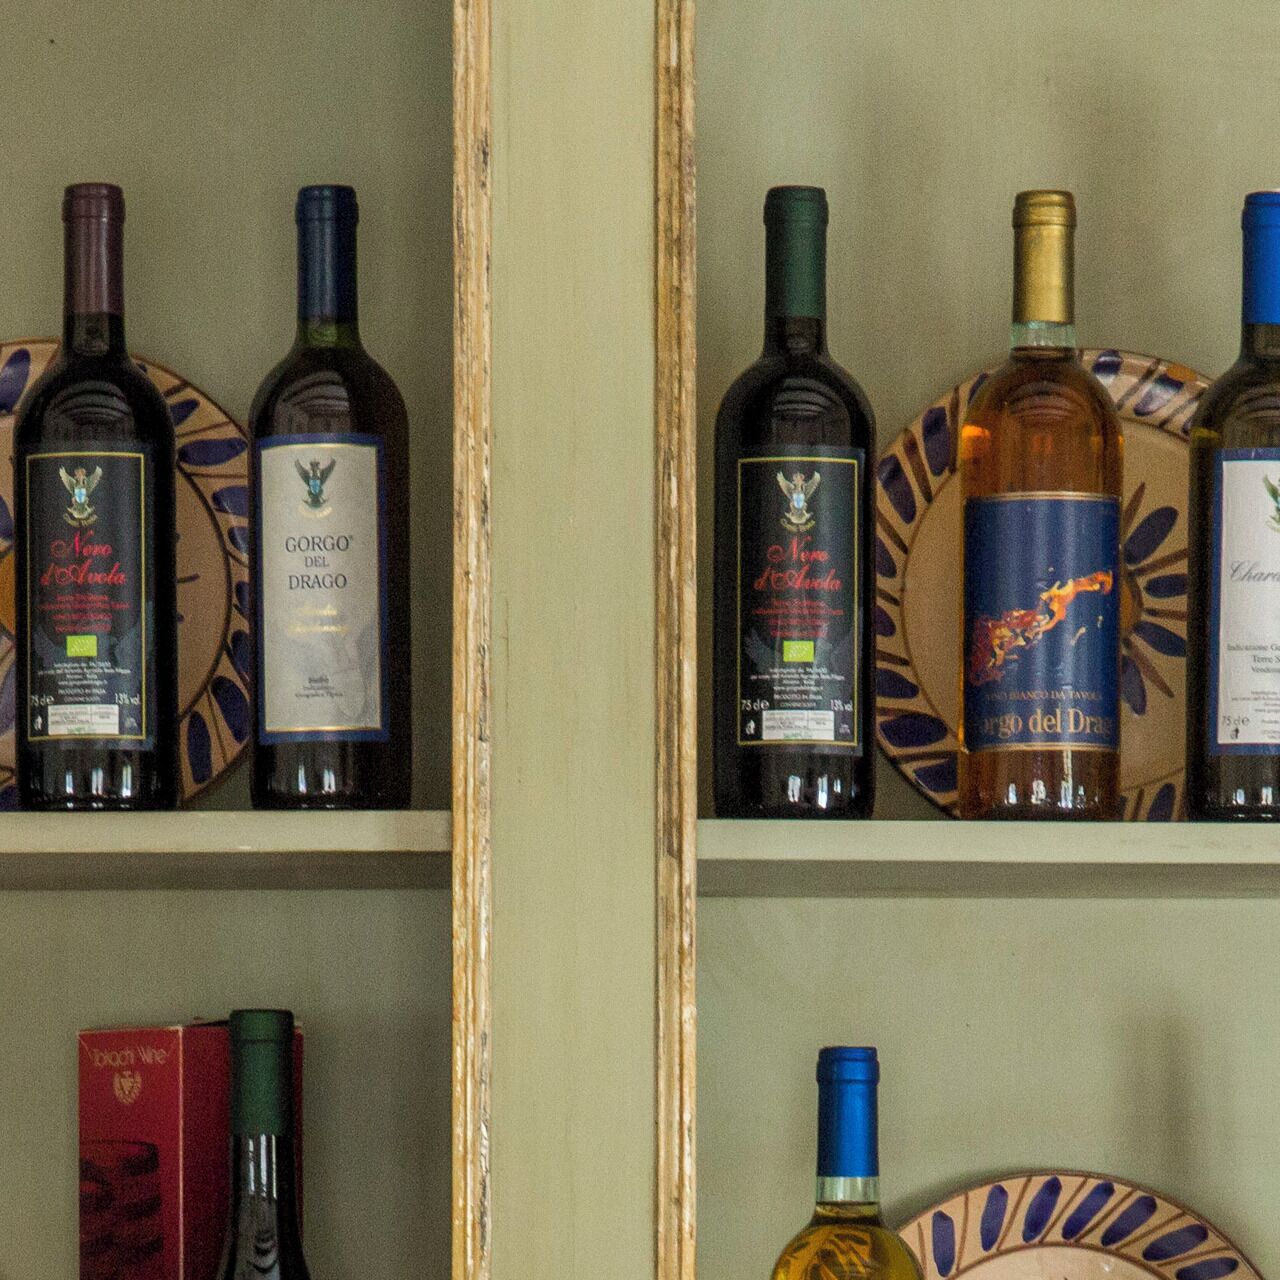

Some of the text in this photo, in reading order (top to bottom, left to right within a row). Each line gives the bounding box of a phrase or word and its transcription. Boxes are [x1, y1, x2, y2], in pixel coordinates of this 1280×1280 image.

[51, 529, 113, 558] Nero
[286, 535, 350, 553] GORGO
[767, 536, 830, 562] Nero
[304, 556, 330, 568] DEL
[288, 573, 348, 590] DRAGO
[1227, 643, 1270, 652] Indicazione
[1252, 654, 1272, 664] Terre
[1009, 689, 1048, 700] BIANCO
[1028, 707, 1062, 734] del
